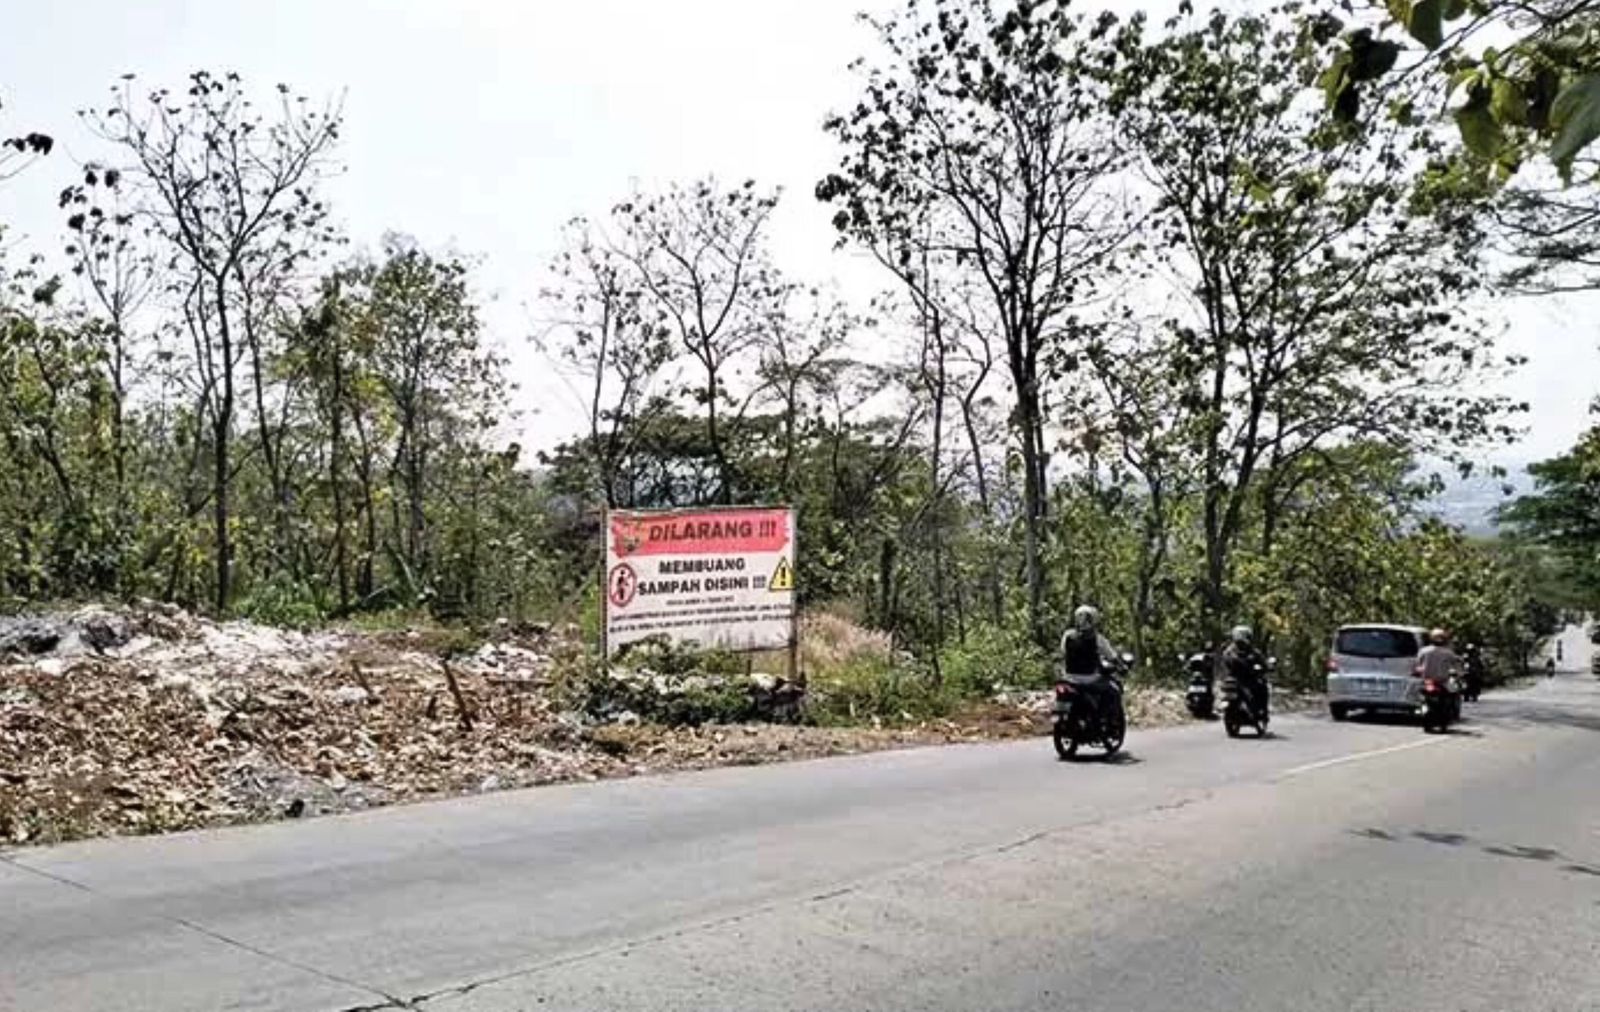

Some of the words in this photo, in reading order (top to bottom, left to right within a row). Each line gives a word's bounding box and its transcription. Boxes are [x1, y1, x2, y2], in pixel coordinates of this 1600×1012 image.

[649, 521, 752, 541] DILARANG
[659, 558, 745, 574] MEMBUANG
[638, 578, 701, 595] SAMPAH
[704, 577, 748, 591] DISINI
